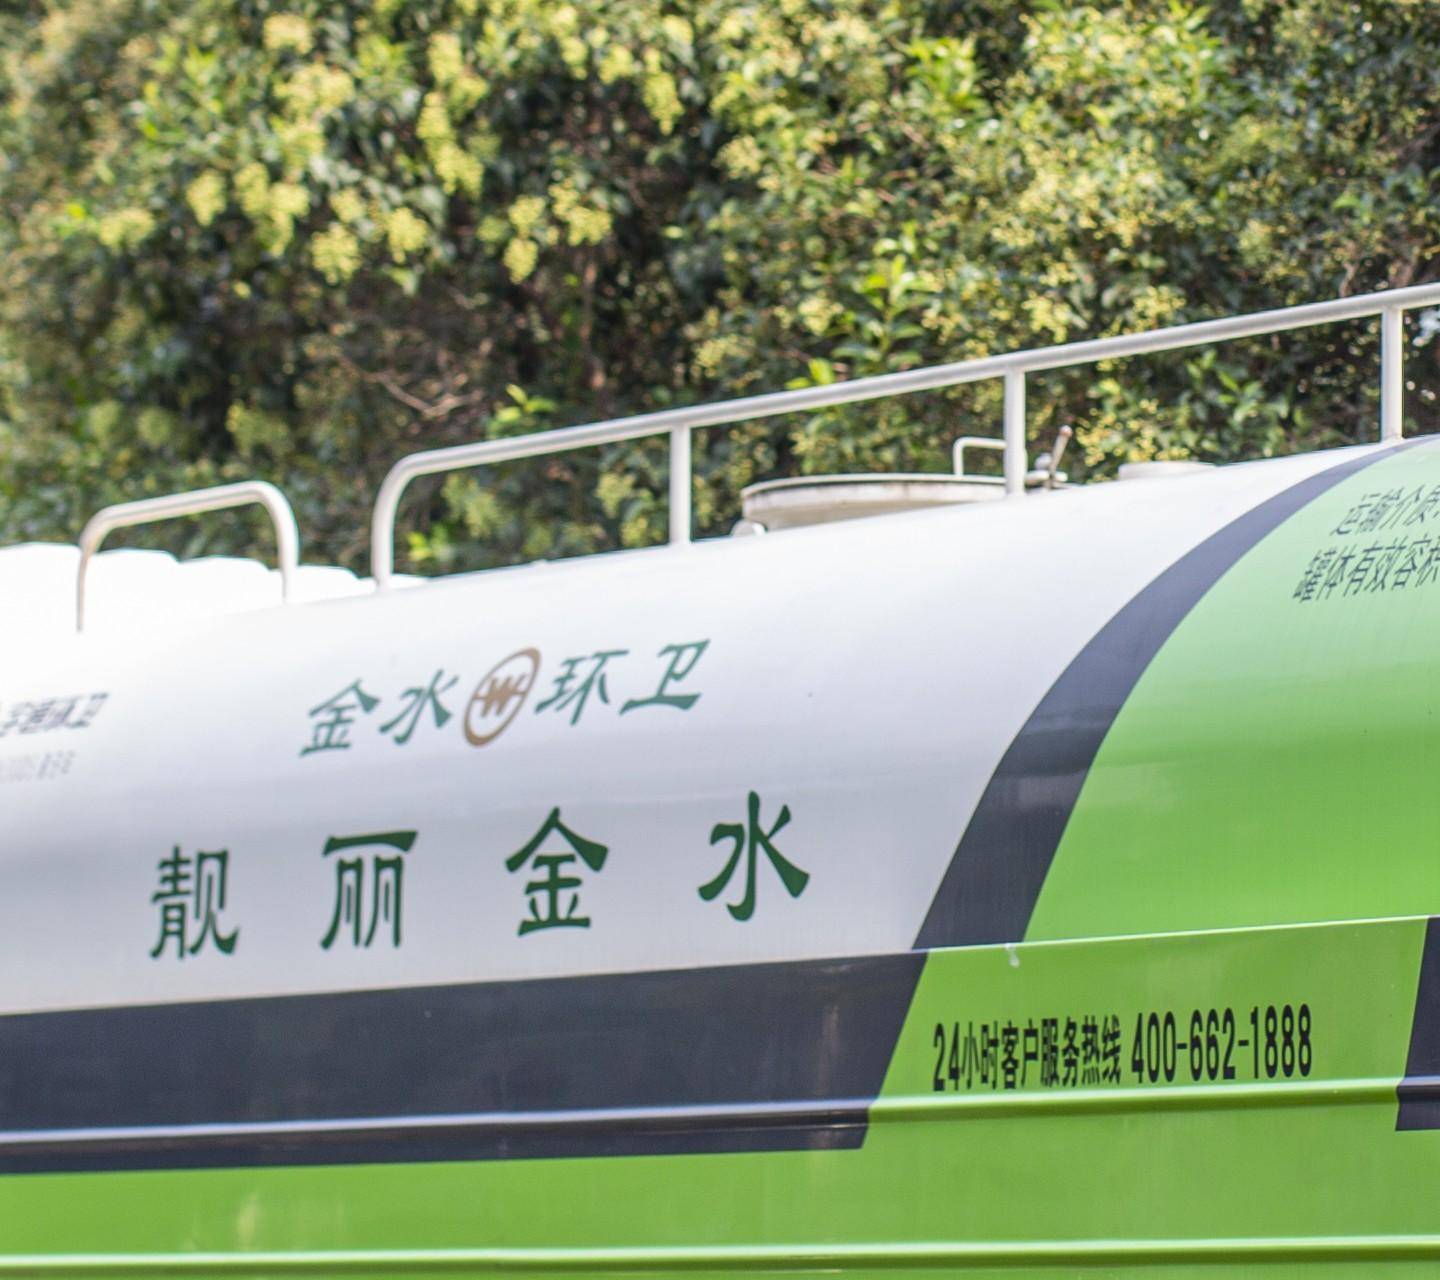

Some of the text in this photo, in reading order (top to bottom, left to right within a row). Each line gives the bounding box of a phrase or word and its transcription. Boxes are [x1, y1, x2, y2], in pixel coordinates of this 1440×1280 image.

[299, 638, 711, 757] 金水 环卫
[150, 790, 811, 961] 靓丽金水
[932, 1003, 1313, 1092] 24小时客户服务热线 400-662-1888
